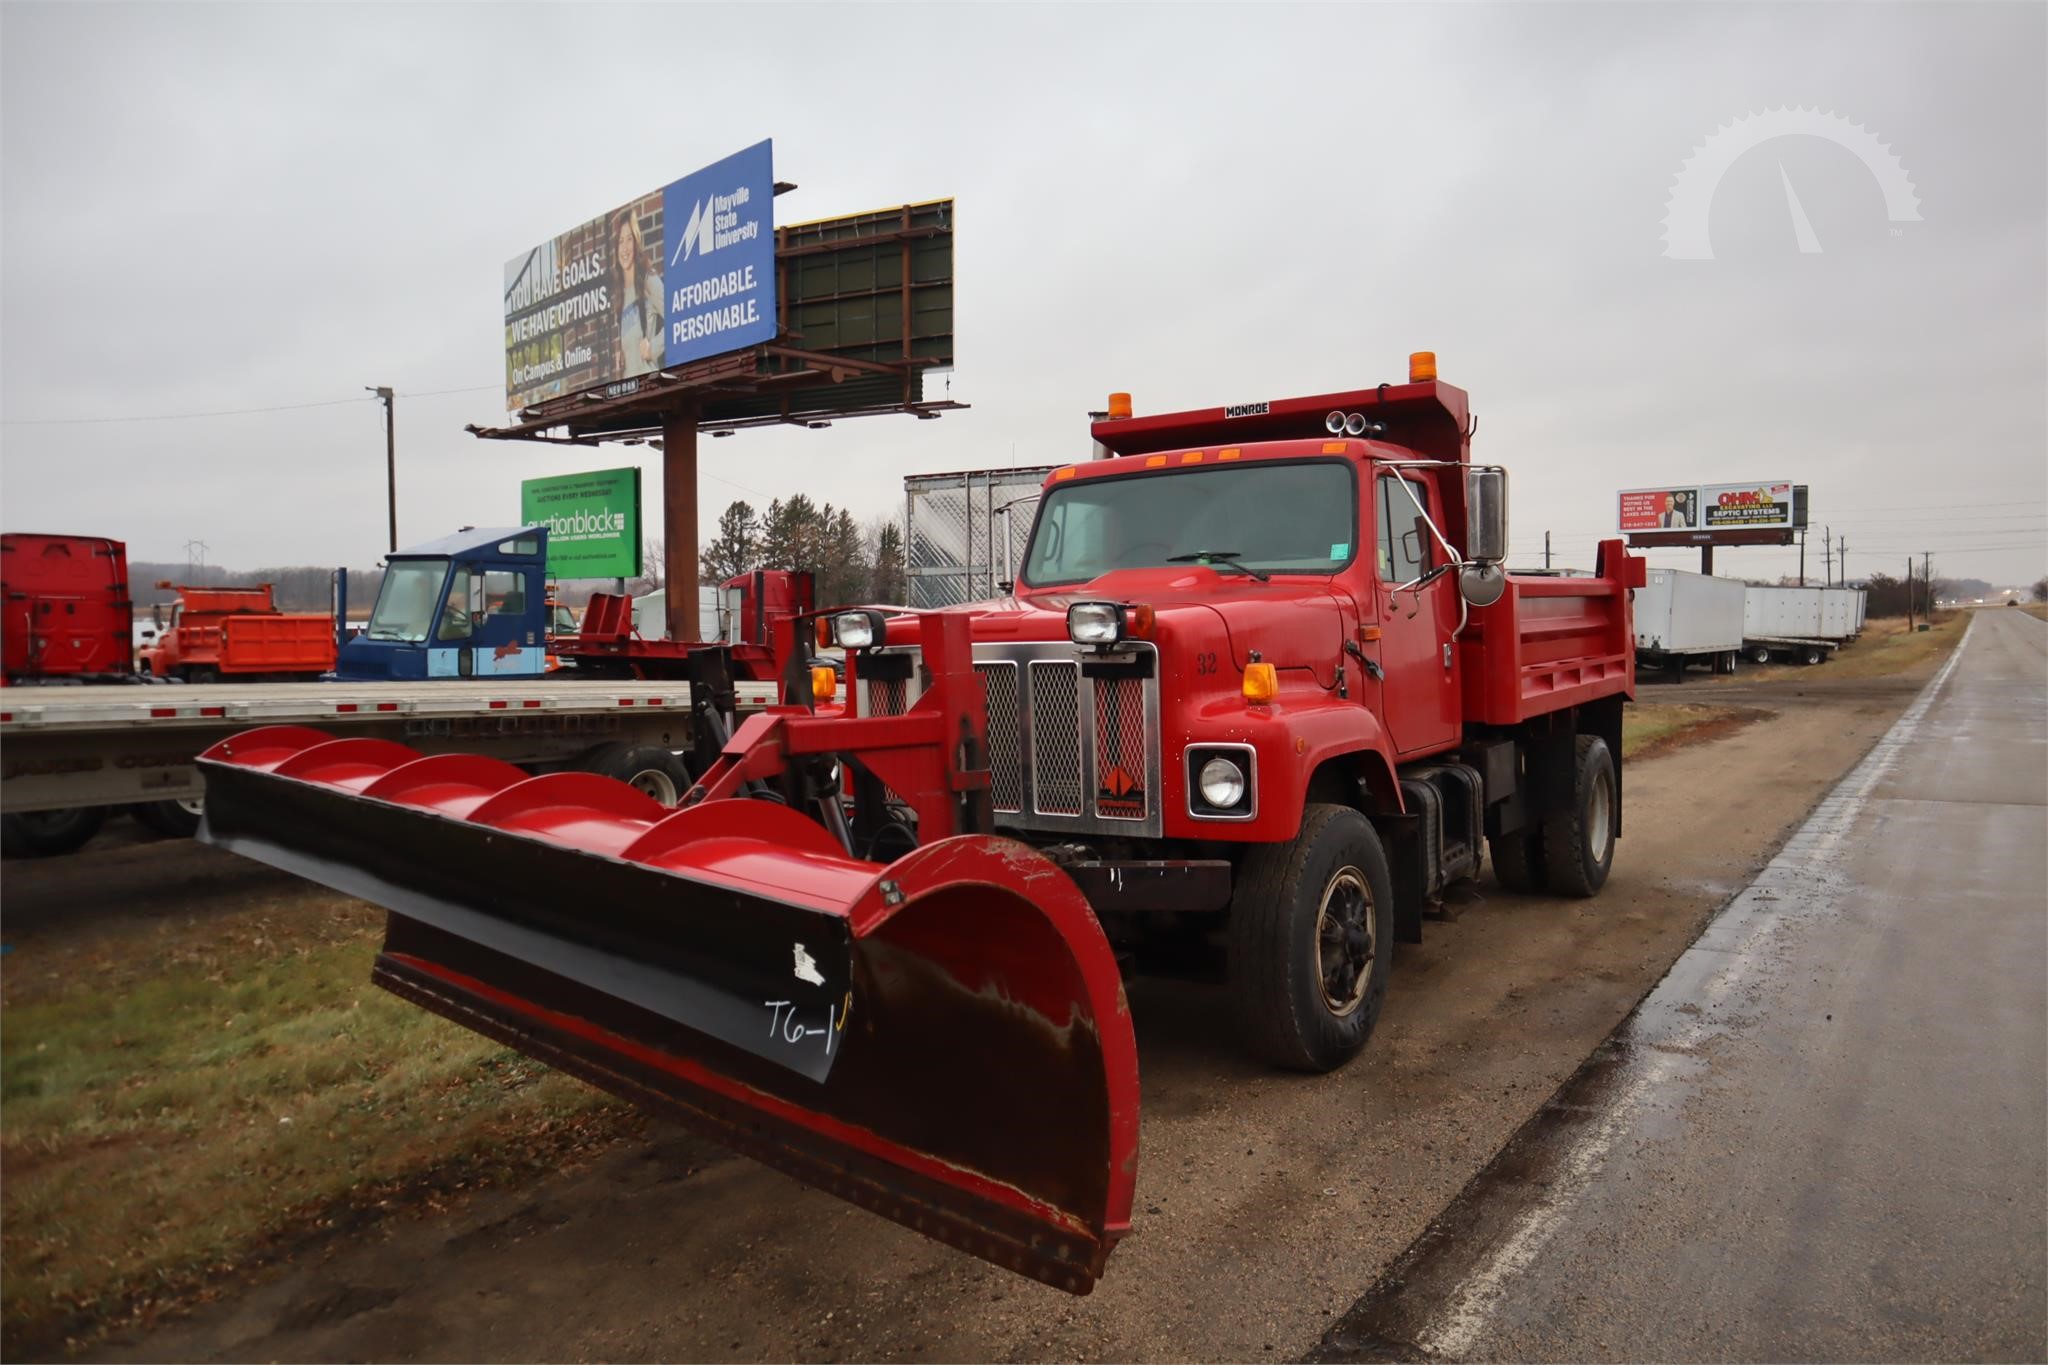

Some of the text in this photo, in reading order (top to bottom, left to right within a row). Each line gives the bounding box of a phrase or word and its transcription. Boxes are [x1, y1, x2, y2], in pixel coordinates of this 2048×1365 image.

[715, 186, 750, 214] Mayville
[715, 211, 737, 231] State
[715, 220, 759, 250] University
[511, 252, 604, 311] YOU HAVE GOALS.
[672, 265, 757, 313] AFFORDABLE.
[512, 320, 527, 343] WE
[529, 311, 556, 335] HAVE
[559, 286, 611, 325] OPTIONS.
[673, 299, 760, 345] PERSONABLE.
[513, 346, 592, 385] On Campus & Online
[1226, 402, 1268, 417] MONROE
[1713, 509, 1741, 517] SEPTIC
[1743, 507, 1780, 516] SYSTEMS
[1196, 652, 1217, 676] 32
